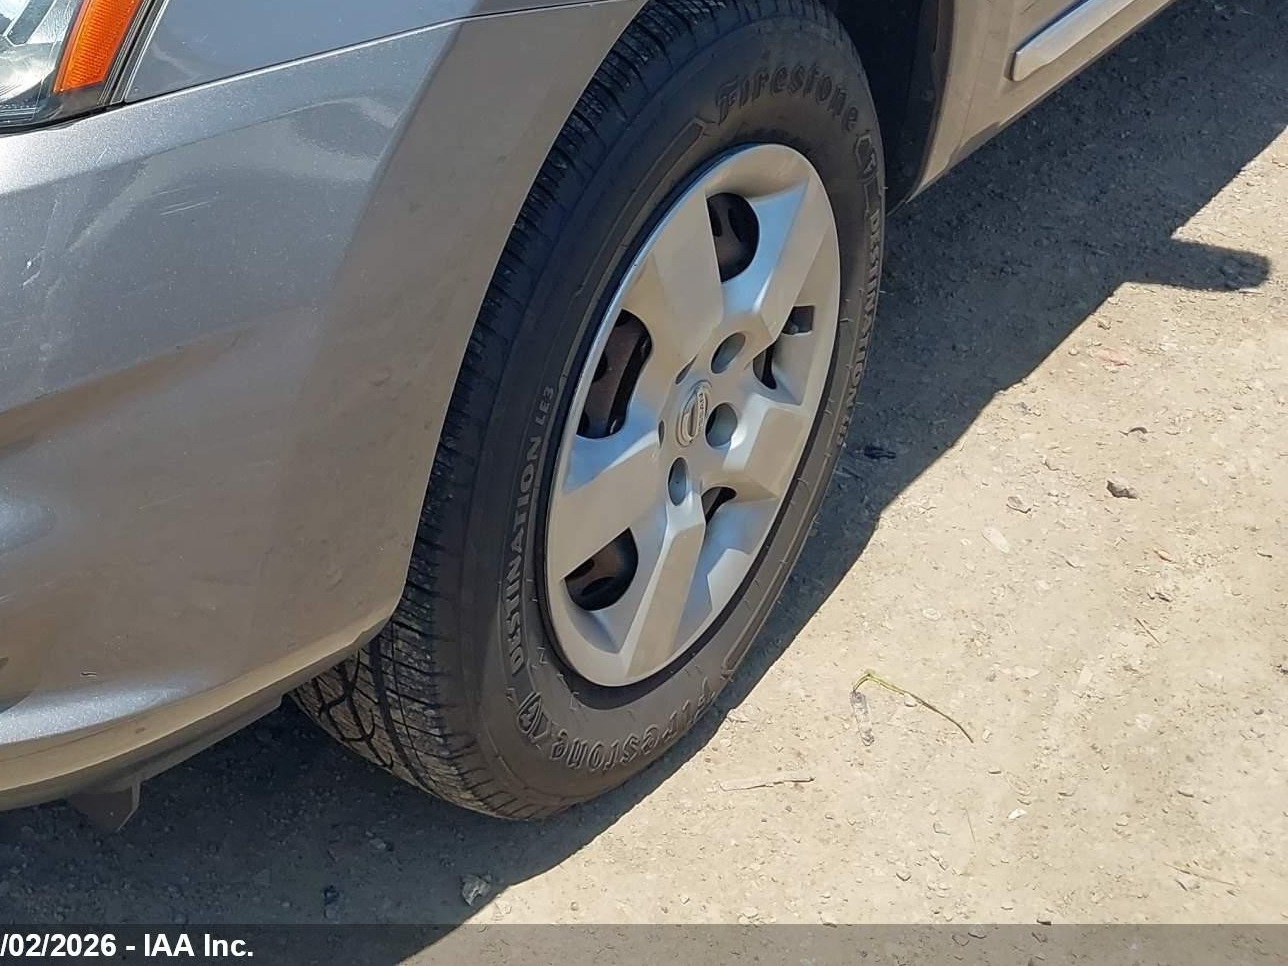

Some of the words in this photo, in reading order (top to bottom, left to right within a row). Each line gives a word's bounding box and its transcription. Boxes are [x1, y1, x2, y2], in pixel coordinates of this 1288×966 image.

[715, 61, 860, 132] Firestone
[505, 435, 543, 675] DESTINATION
[535, 386, 554, 426] LE3
[550, 676, 717, 772] Firestone
